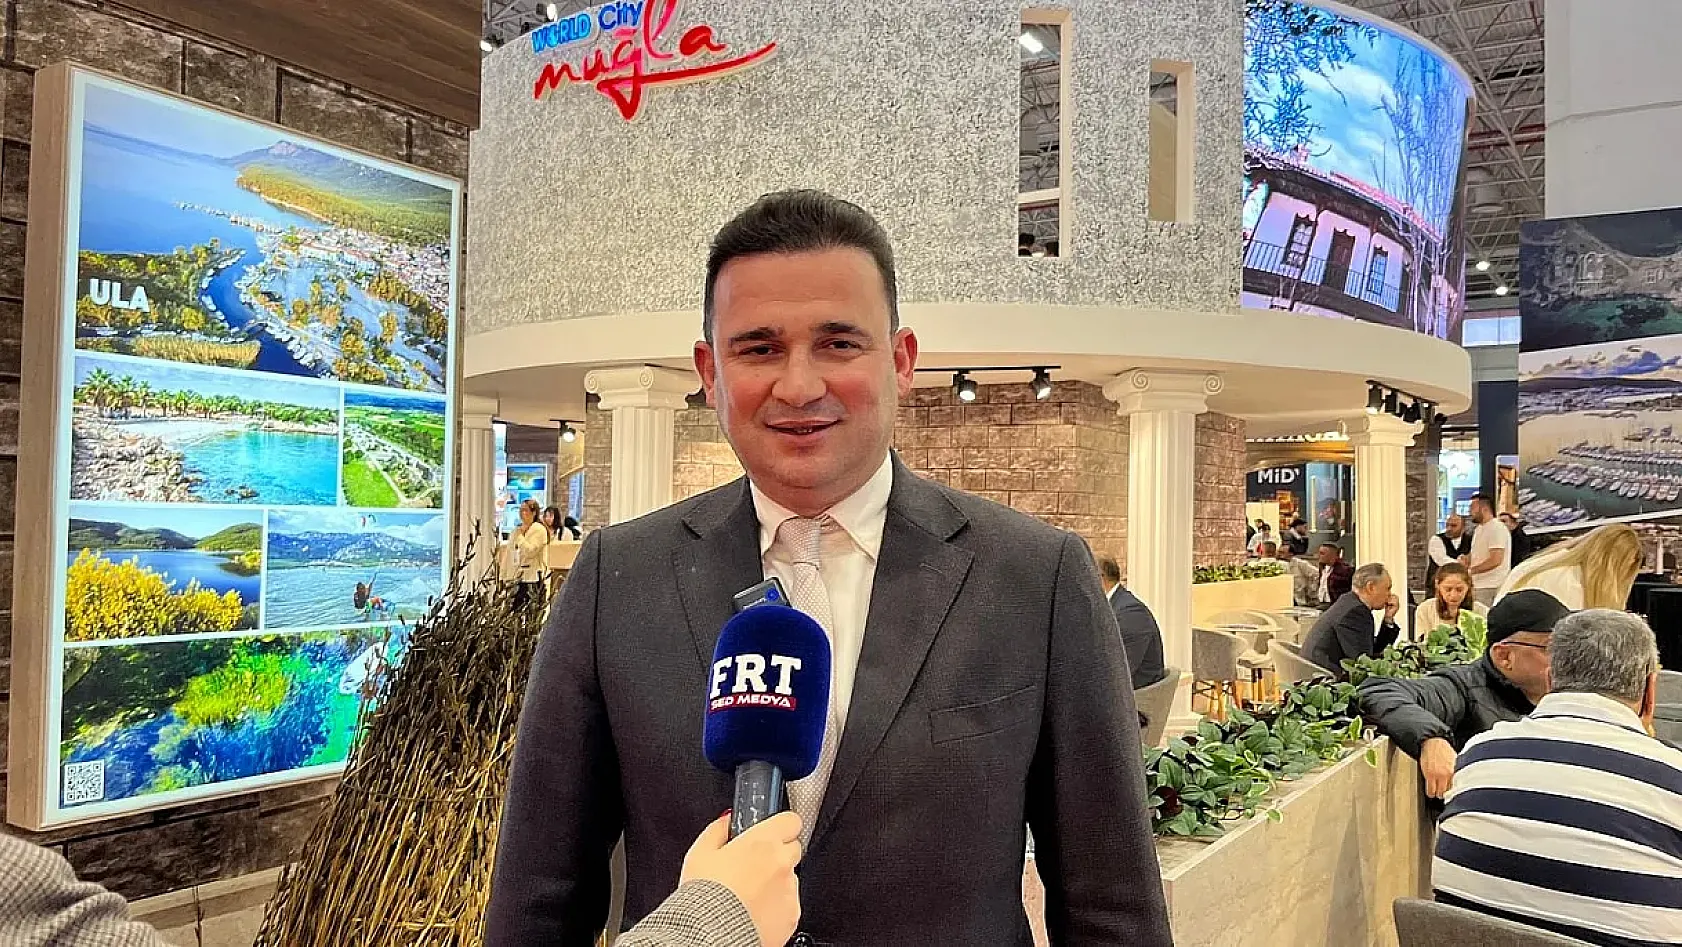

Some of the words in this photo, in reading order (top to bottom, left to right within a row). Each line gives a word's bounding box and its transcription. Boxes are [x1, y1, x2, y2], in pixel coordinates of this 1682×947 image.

[532, 13, 592, 52] WORLD
[598, 1, 643, 30] City
[89, 278, 151, 312] ULA
[710, 653, 802, 699] FRT
[737, 693, 791, 708] MEDYA
